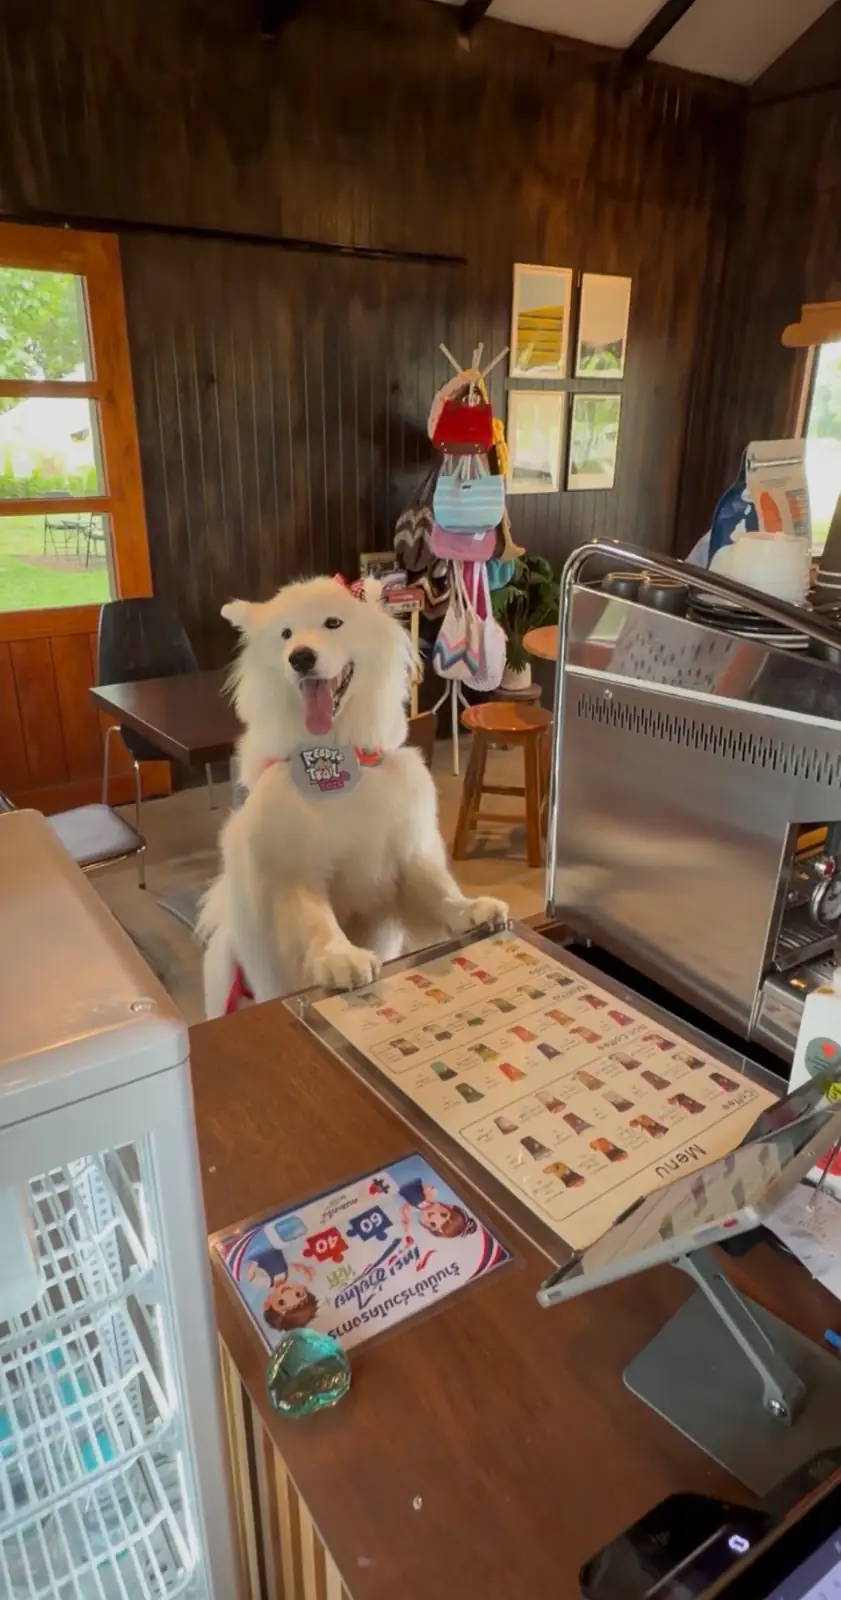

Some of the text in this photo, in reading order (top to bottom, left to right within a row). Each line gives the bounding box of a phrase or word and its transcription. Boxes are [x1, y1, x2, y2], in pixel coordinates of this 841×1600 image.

[721, 1089, 755, 1110] Coffee
[655, 1144, 707, 1178] Menu
[359, 1211, 383, 1233] 60
[315, 1235, 338, 1254] 40
[327, 1261, 460, 1340] ร้านนี้เข้าร่วมโครงการ
